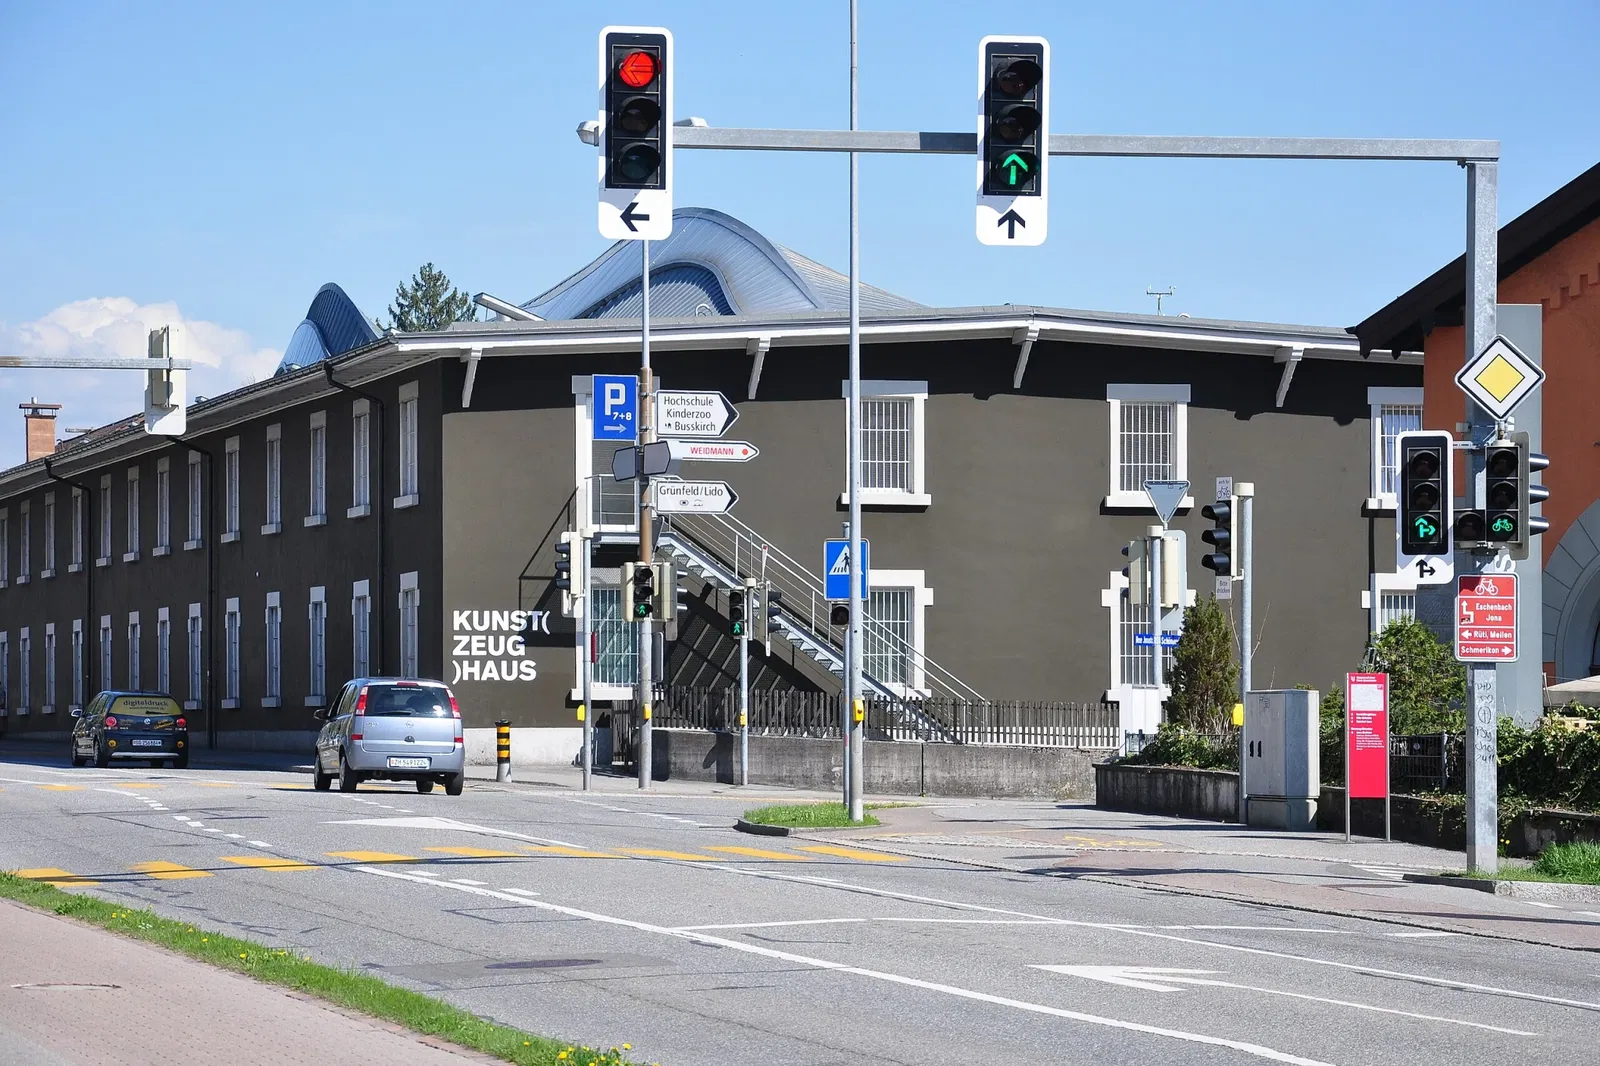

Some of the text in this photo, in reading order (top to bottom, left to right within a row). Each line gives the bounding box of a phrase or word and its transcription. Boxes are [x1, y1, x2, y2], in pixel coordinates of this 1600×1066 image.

[605, 383, 626, 415] P
[664, 396, 714, 406] Hochschule
[612, 411, 632, 421] 7+8
[666, 408, 711, 418] Kinderzoo
[675, 421, 716, 431] Busskirch
[690, 447, 734, 455] WEIDMANN
[660, 485, 724, 497] Grünfeld/Lido
[1475, 602, 1513, 611] Eschenbach
[1485, 614, 1503, 622] Jona
[452, 635, 526, 656] ZEUG
[1460, 645, 1500, 654] Schmerikon
